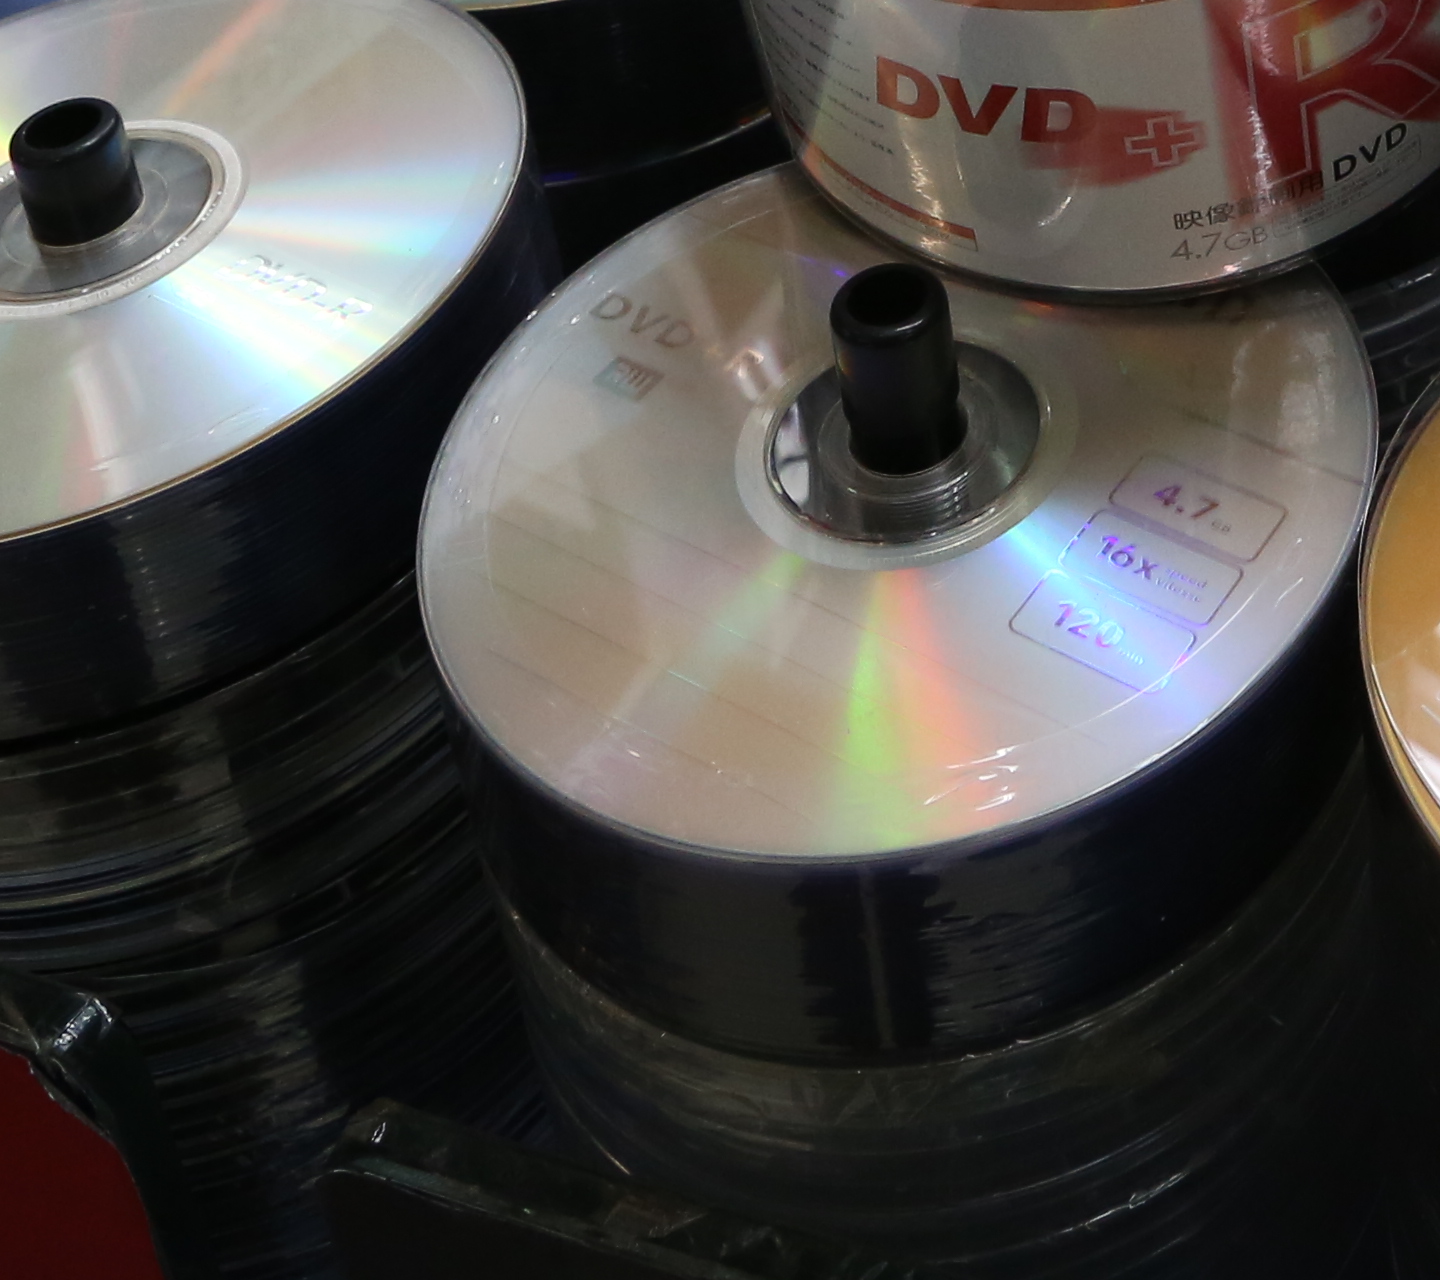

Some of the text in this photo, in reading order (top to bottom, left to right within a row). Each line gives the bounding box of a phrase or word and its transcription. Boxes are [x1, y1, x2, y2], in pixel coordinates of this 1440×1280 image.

[1332, 120, 1409, 183] DVD
[1169, 225, 1271, 262] 4.7GB
[1153, 484, 1221, 521] 4.7
[1053, 599, 1125, 649] 120
